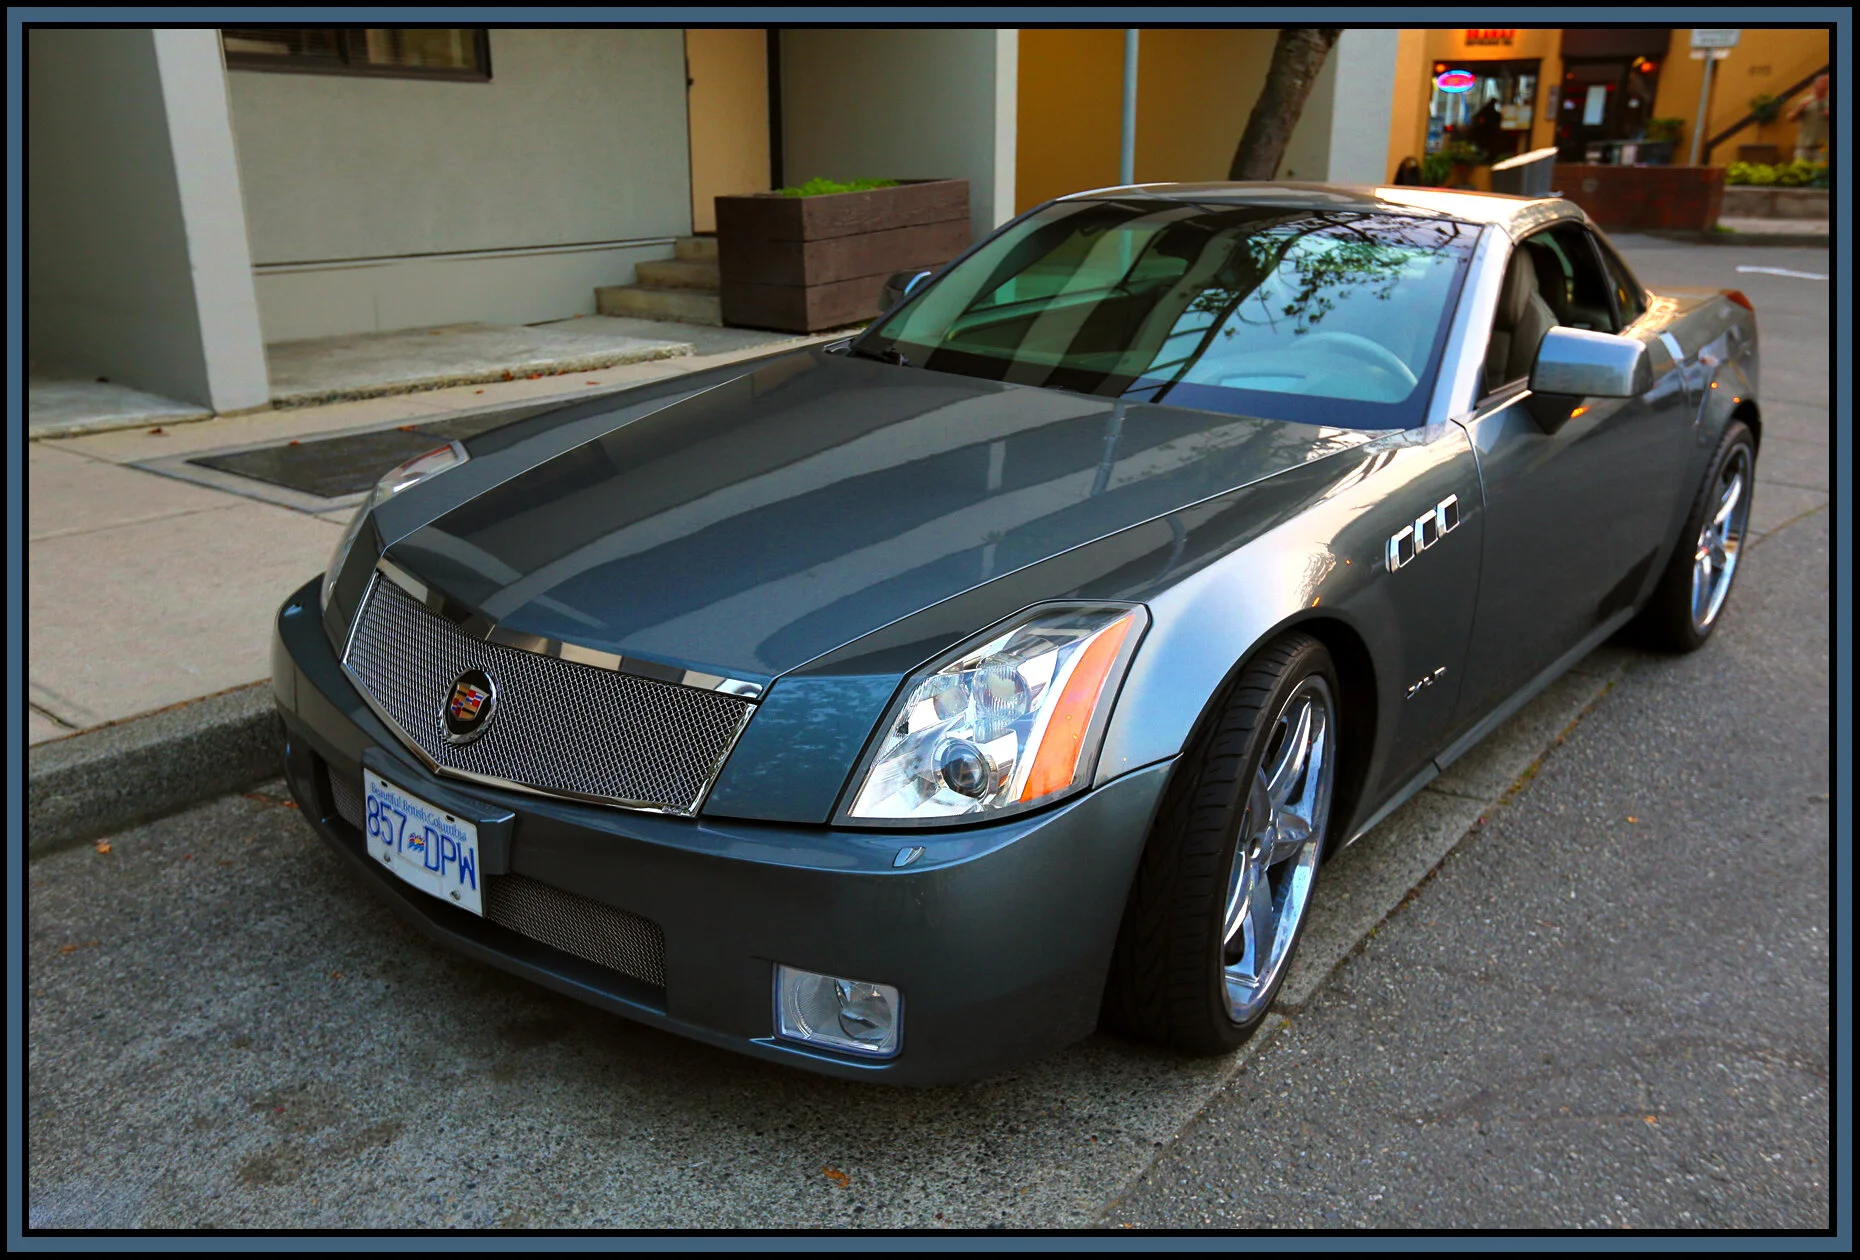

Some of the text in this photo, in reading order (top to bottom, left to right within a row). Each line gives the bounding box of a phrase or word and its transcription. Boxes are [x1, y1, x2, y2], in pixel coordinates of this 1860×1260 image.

[367, 794, 477, 891] 857 DPW
[371, 782, 467, 842] Beautiful British Columbia
